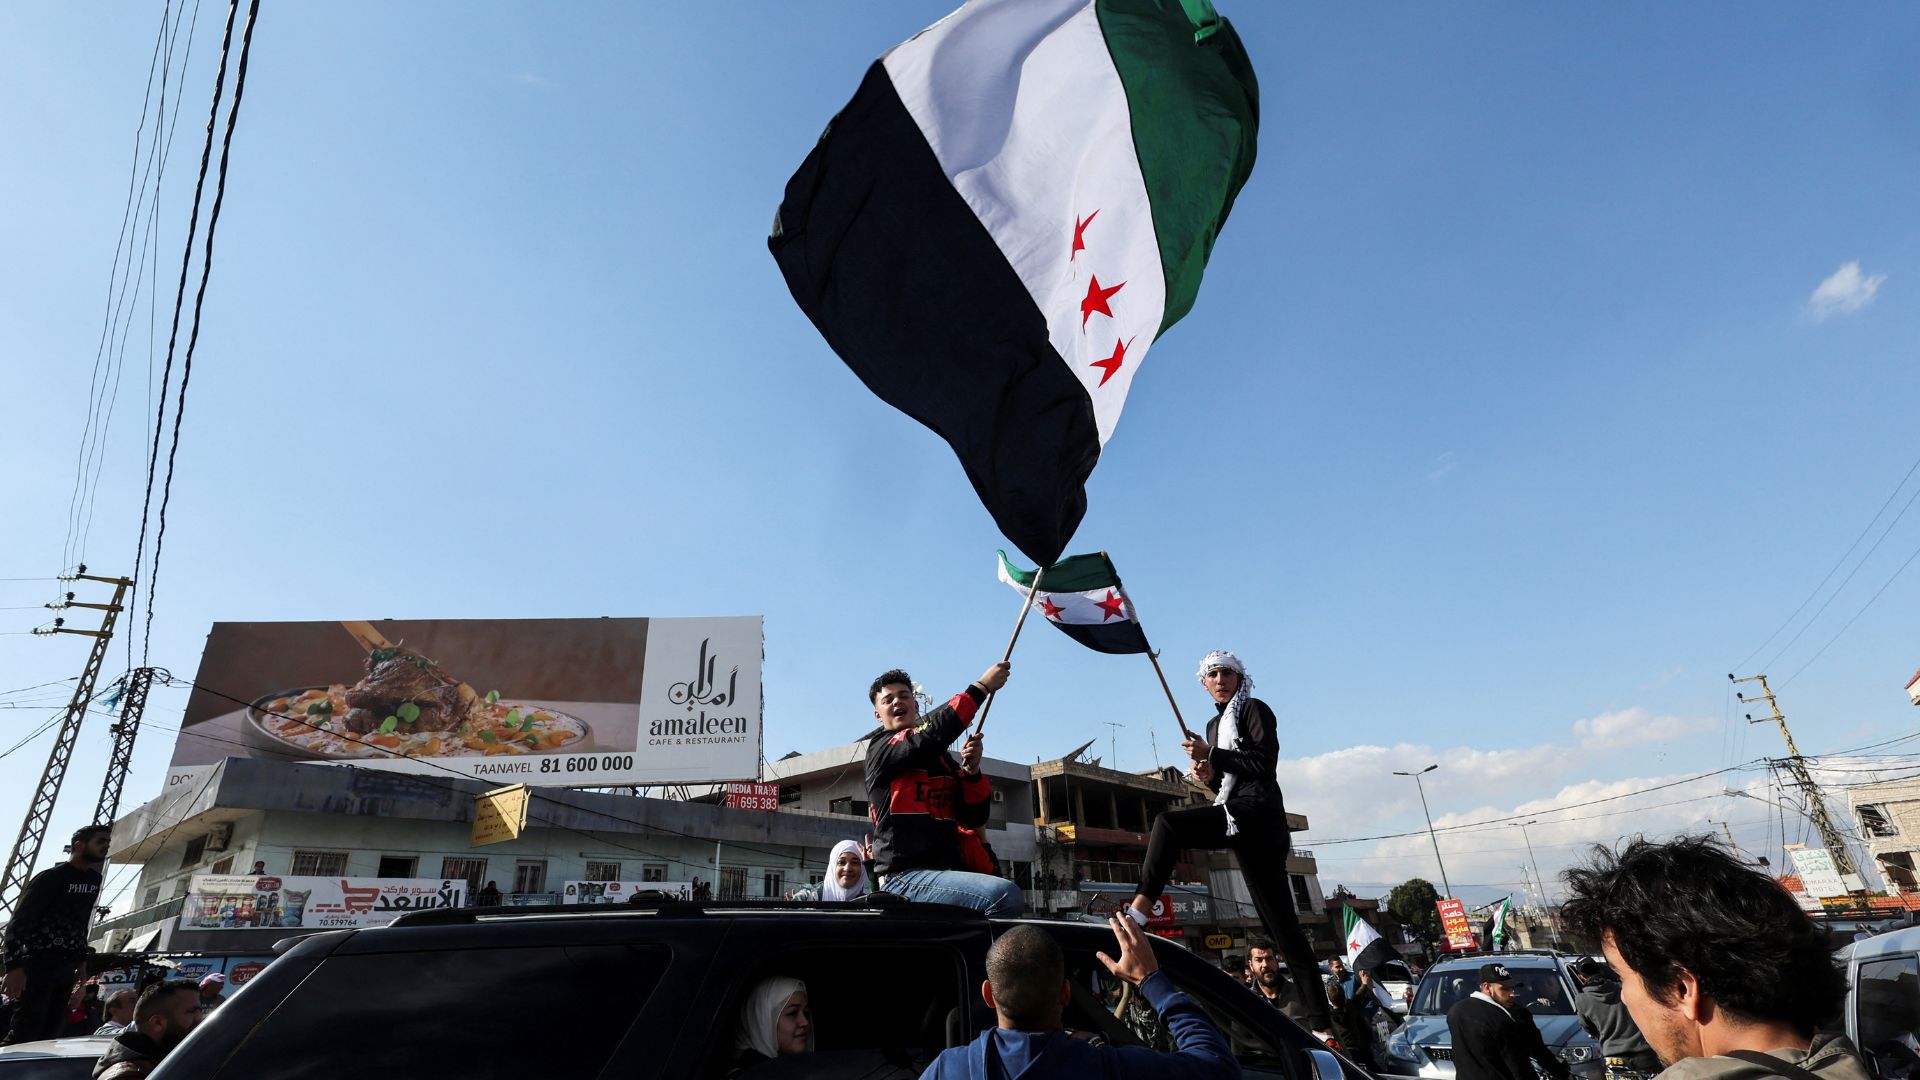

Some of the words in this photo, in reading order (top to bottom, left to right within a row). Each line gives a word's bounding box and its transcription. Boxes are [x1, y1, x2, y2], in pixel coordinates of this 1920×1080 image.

[649, 711, 747, 736] amaleen
[649, 738, 673, 746] CAFE
[685, 736, 747, 745] RESTAURANT
[473, 762, 533, 775] TAANAYEL
[540, 758, 561, 773] 81
[566, 756, 598, 772] 600
[602, 755, 633, 771] 000
[727, 783, 752, 794] MEDIA
[754, 785, 778, 796] TRADE
[760, 797, 777, 810] 383
[382, 885, 409, 894] ماركت
[373, 880, 460, 911] الأسعد
[1441, 902, 1458, 911] سنتر
[1444, 910, 1463, 918] حامد
[1208, 937, 1228, 946] OMT
